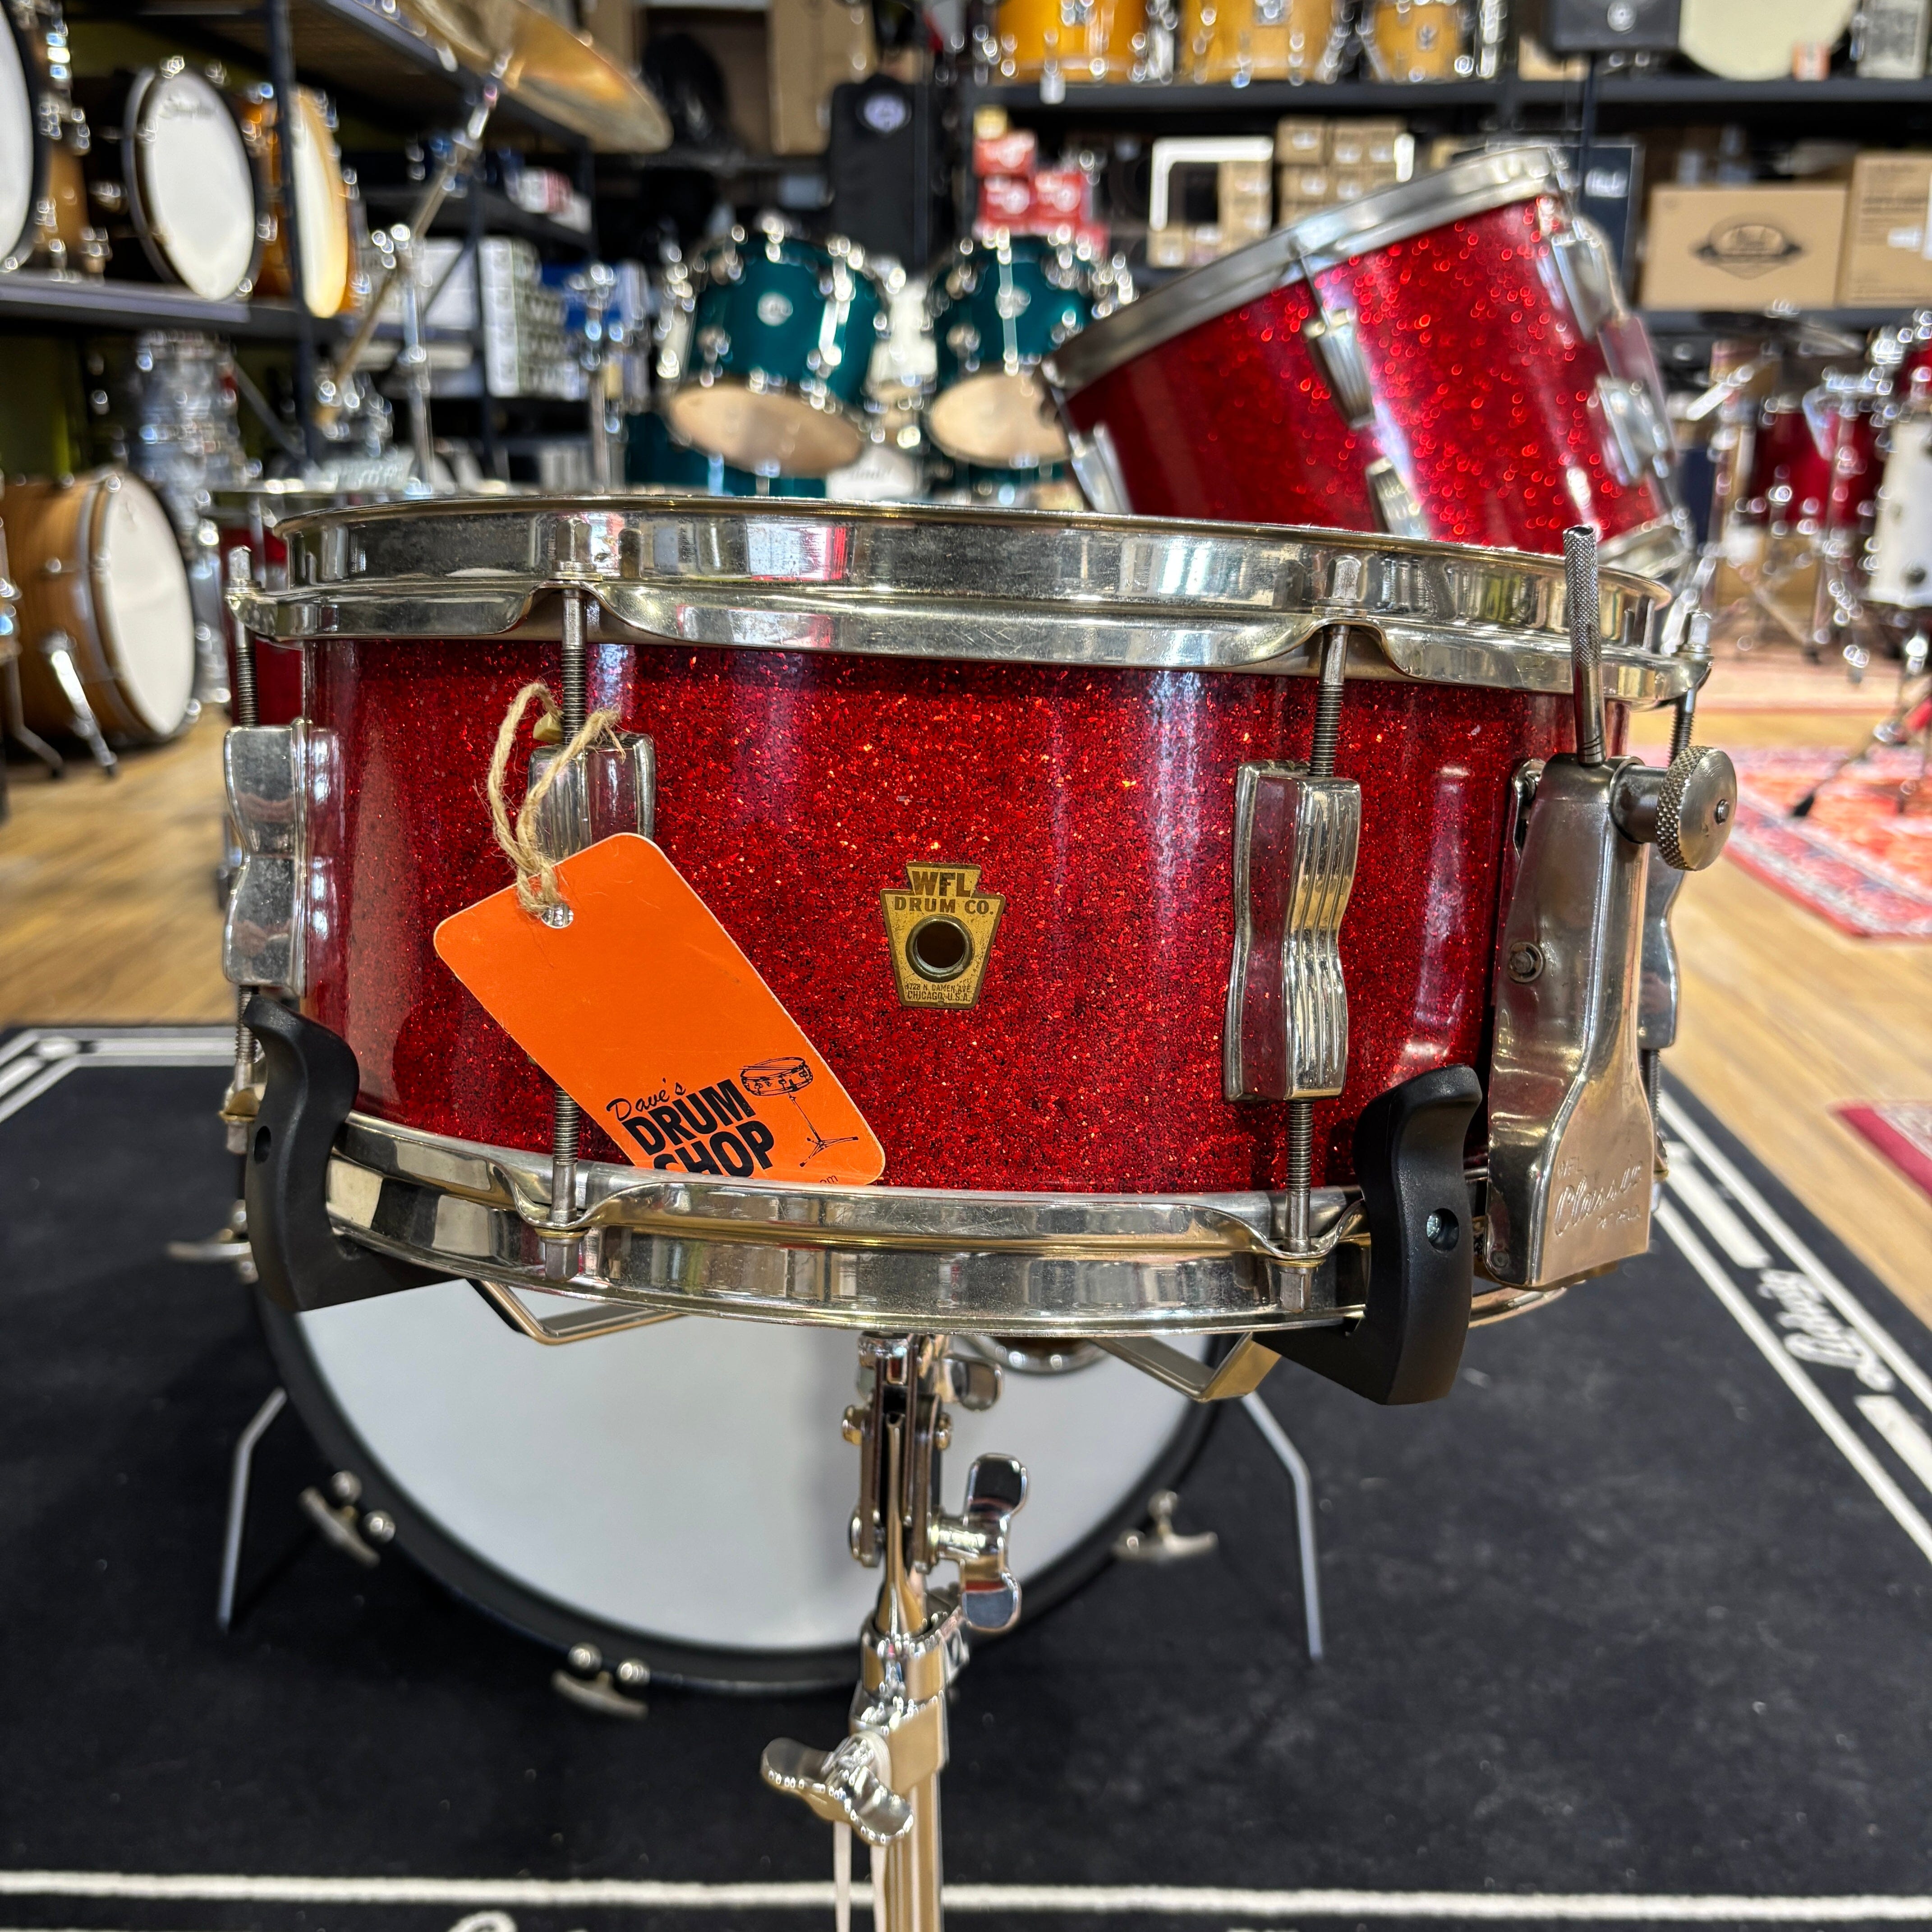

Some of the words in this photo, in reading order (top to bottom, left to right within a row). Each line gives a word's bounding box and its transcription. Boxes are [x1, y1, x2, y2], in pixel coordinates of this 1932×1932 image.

[911, 870, 971, 897] WFL
[894, 897, 956, 913] DRUM
[964, 900, 994, 915] CO.
[932, 984, 956, 993] DAMEN
[606, 1078, 686, 1122] Dave's
[622, 1079, 755, 1155] DRUM
